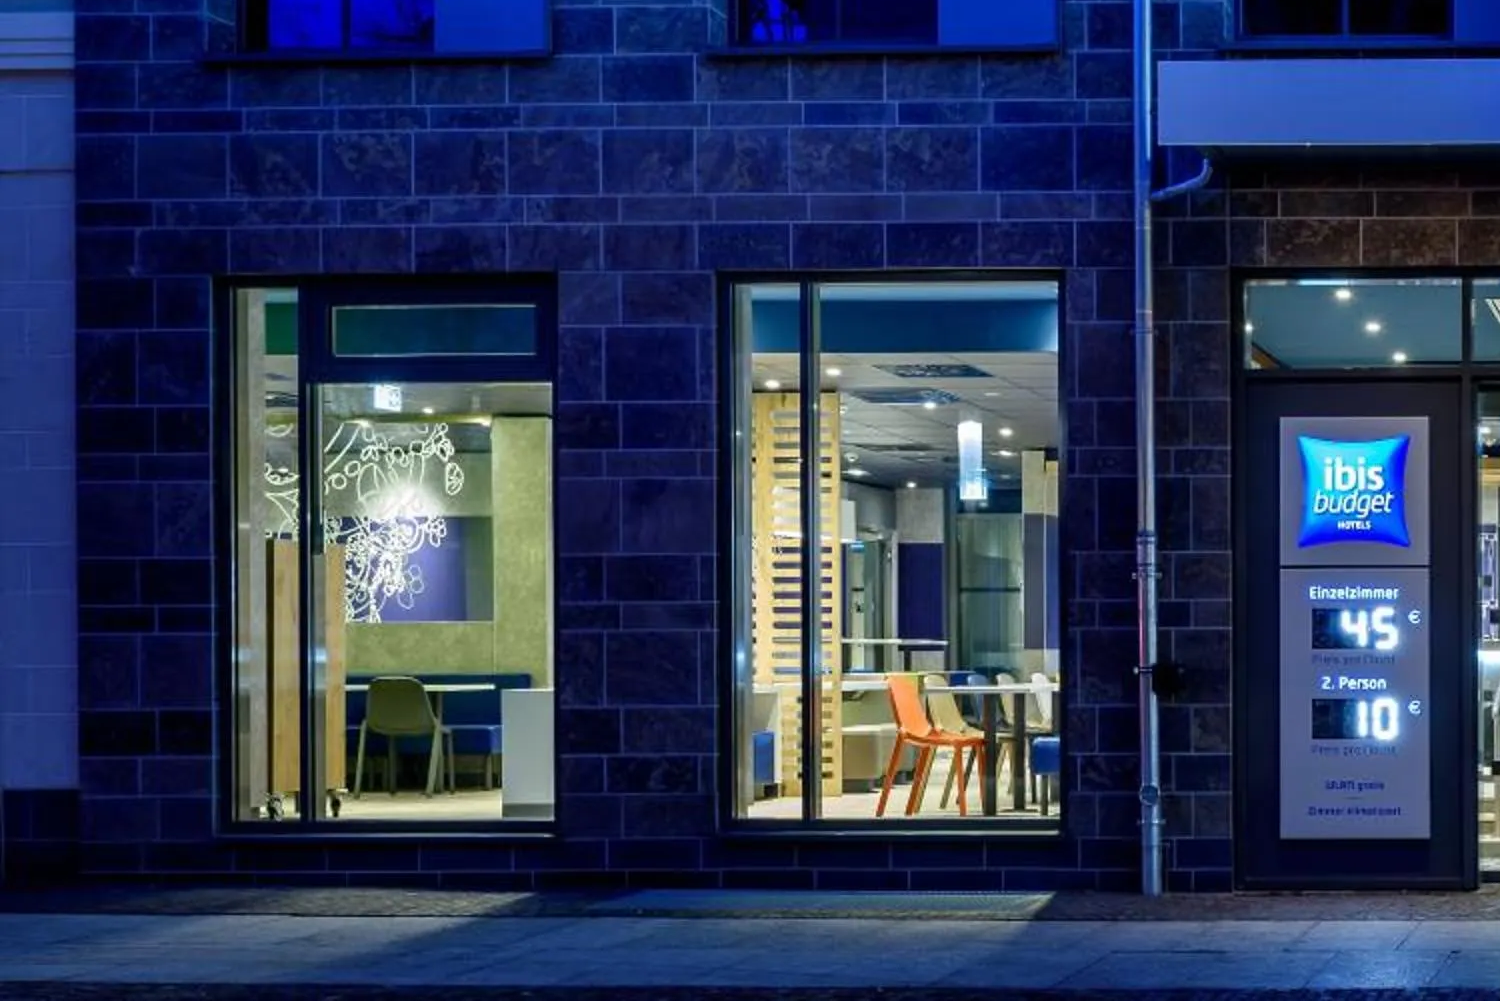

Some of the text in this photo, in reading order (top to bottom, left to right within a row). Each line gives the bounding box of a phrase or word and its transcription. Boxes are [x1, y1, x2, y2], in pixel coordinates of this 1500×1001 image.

[1323, 457, 1385, 491] ibis
[1313, 490, 1395, 518] budget
[1337, 520, 1371, 530] HOTELS
[1309, 586, 1399, 600] Einzelzimmer
[1341, 606, 1421, 649] 45 €
[1321, 676, 1387, 690] 2. Person
[1356, 698, 1421, 740] 10 €
